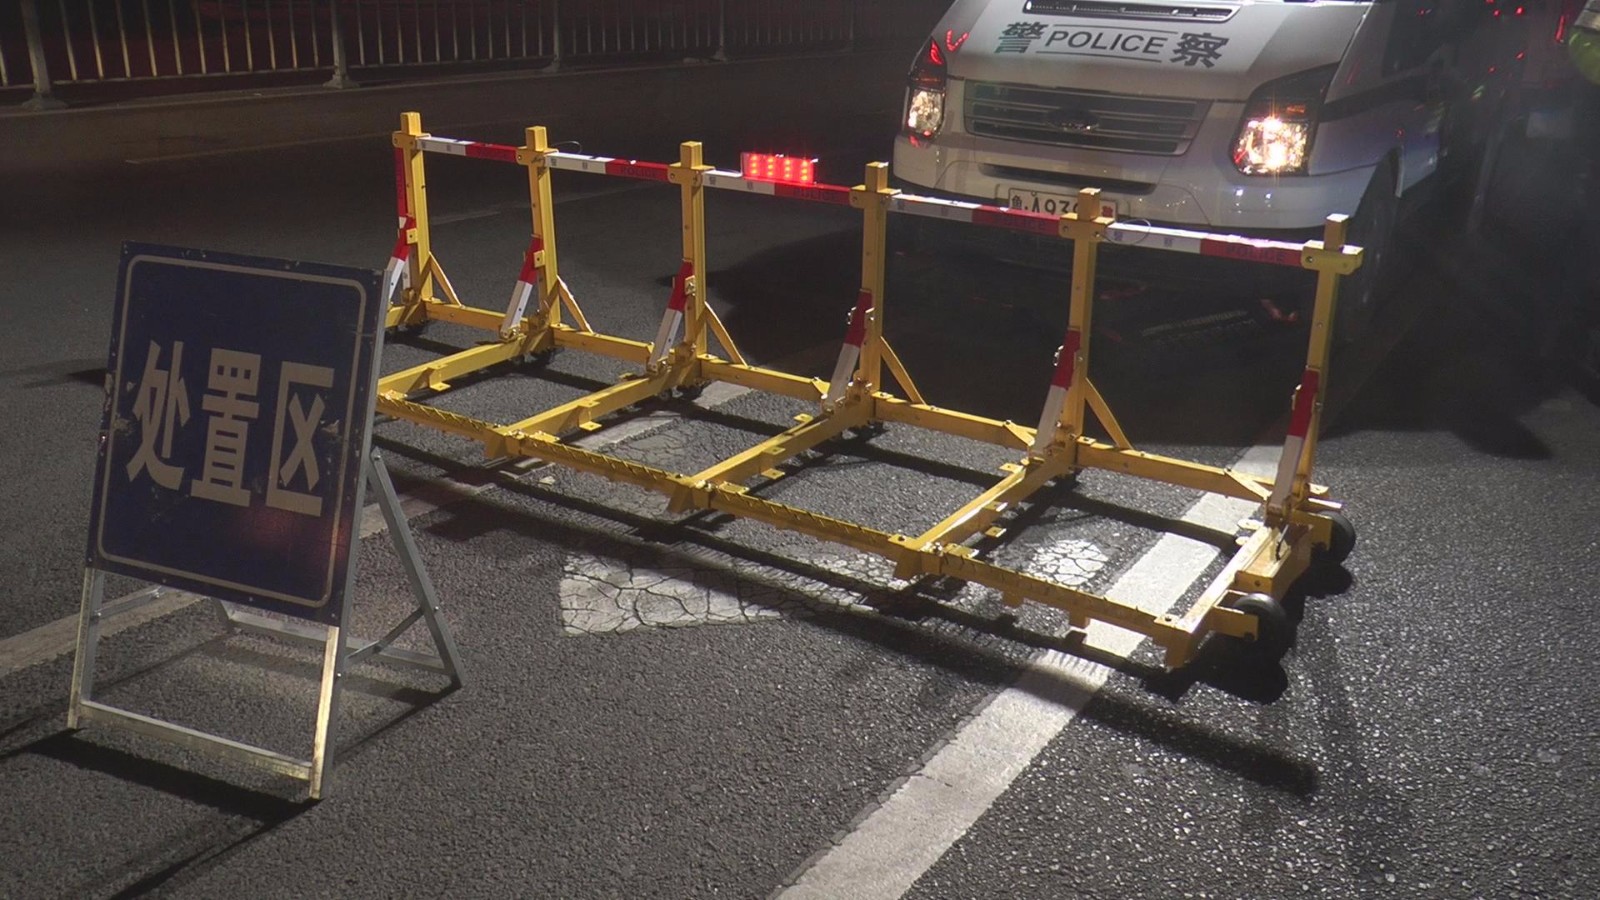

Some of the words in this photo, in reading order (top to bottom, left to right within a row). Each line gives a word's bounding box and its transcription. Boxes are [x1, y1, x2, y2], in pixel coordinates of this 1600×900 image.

[995, 22, 1048, 53] 警
[1045, 31, 1168, 54] POLICE
[1170, 33, 1229, 68] 察
[126, 341, 335, 517] 处置区
